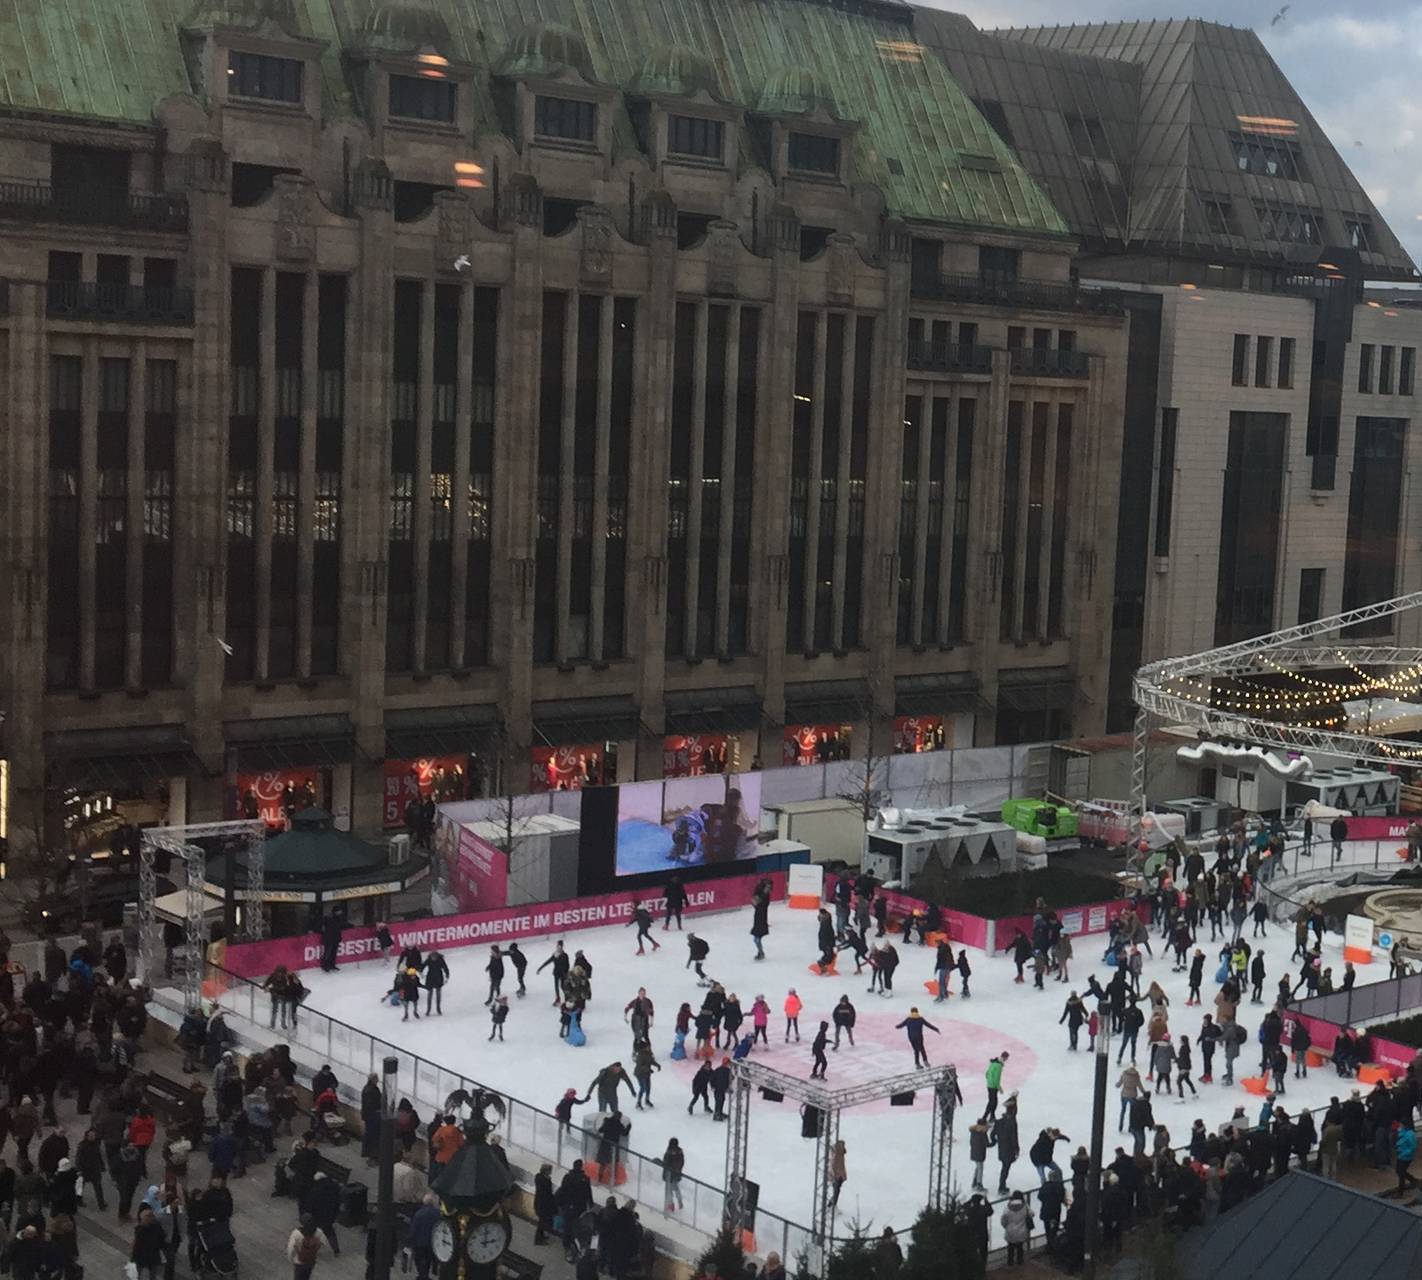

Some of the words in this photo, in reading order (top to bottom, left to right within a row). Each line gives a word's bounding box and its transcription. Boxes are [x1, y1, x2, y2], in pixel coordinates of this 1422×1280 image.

[335, 935, 395, 957] BESTE
[399, 916, 531, 948] WINTERMOMENTE
[533, 913, 550, 929] IM
[553, 905, 607, 927] BESTEN
